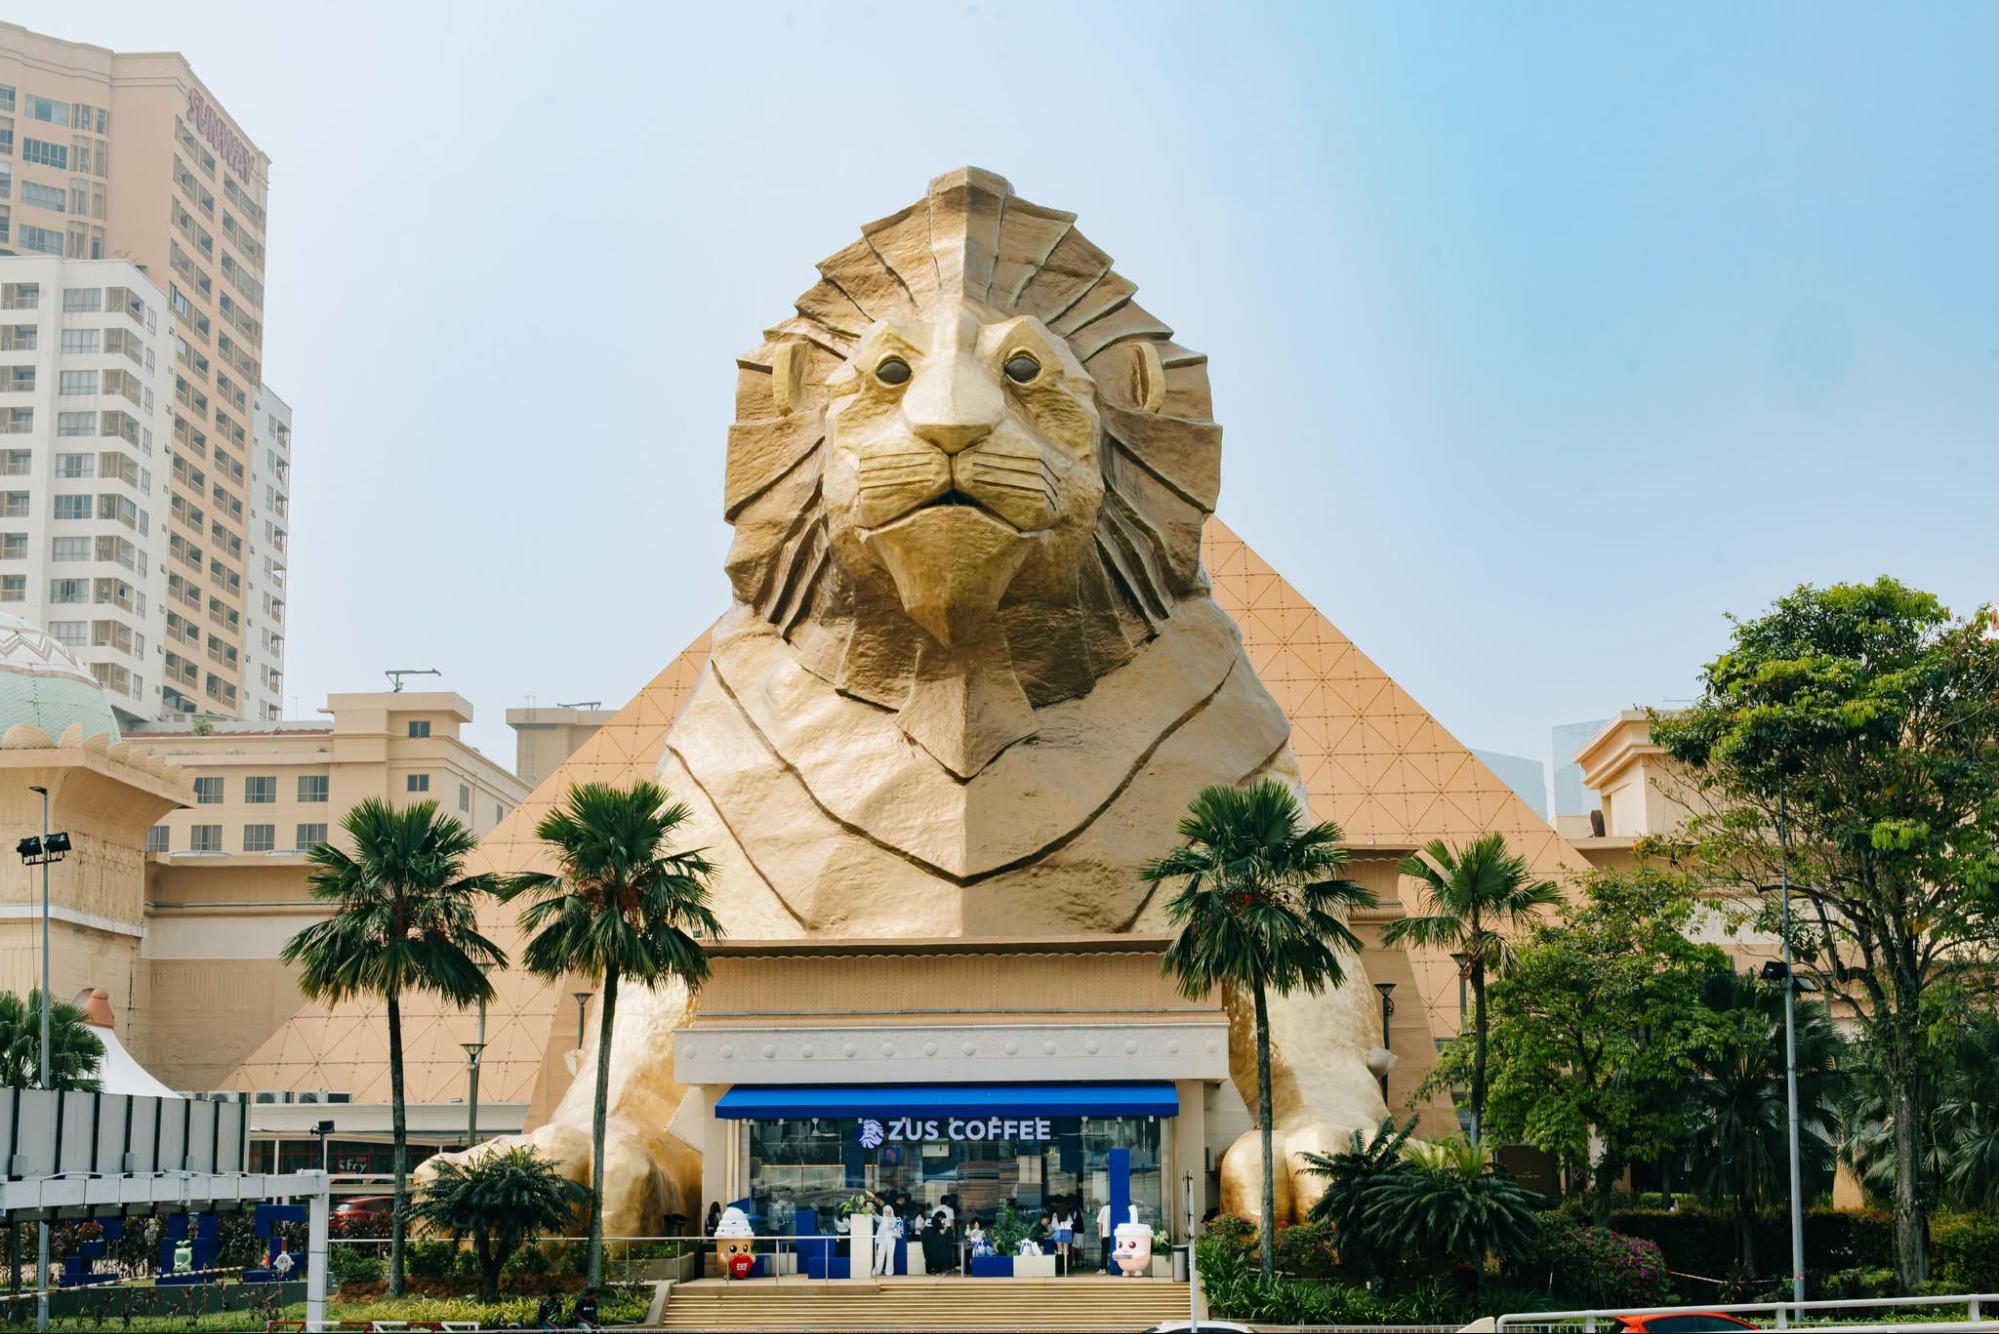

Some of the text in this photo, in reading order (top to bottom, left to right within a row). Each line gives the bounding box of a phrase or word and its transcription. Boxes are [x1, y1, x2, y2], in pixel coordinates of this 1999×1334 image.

[187, 88, 255, 185] SUNWAY
[888, 1120, 1051, 1141] ZUS COFFEE
